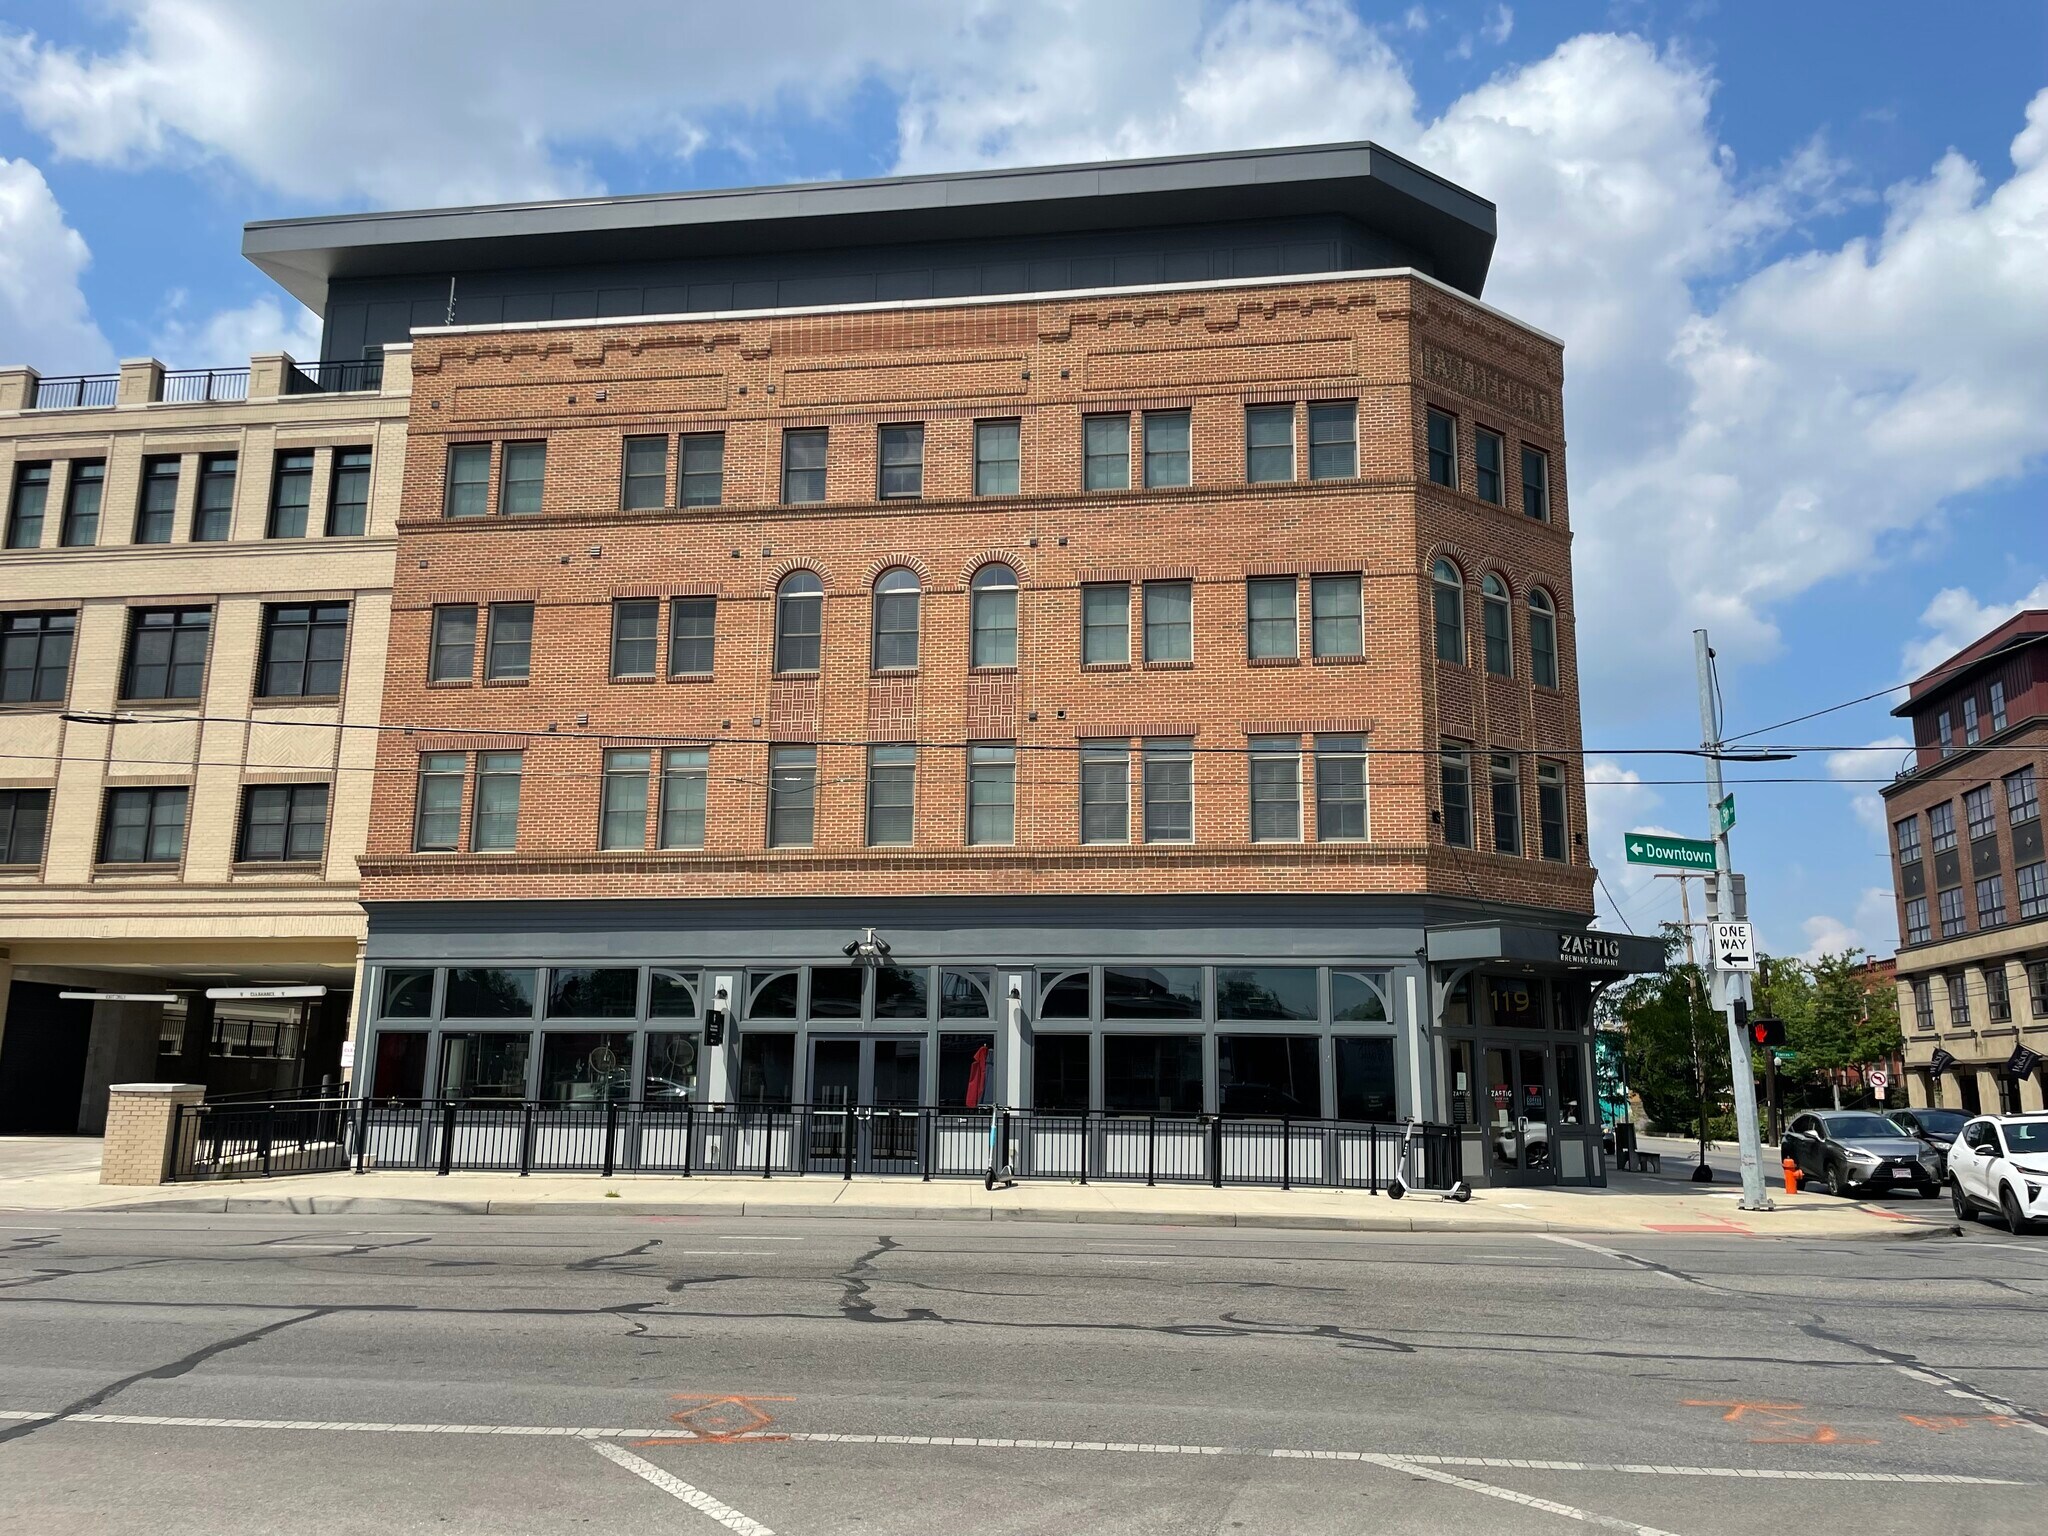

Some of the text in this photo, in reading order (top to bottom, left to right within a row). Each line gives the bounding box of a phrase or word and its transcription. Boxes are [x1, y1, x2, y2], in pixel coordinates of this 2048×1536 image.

[1646, 843, 1712, 863] Downtown
[1720, 926, 1746, 937] ONE
[1561, 934, 1620, 957] ZAFTIG
[1720, 939, 1747, 950] WAY
[1560, 953, 1619, 966] BREWING COMPANY
[1490, 990, 1530, 1011] 119
